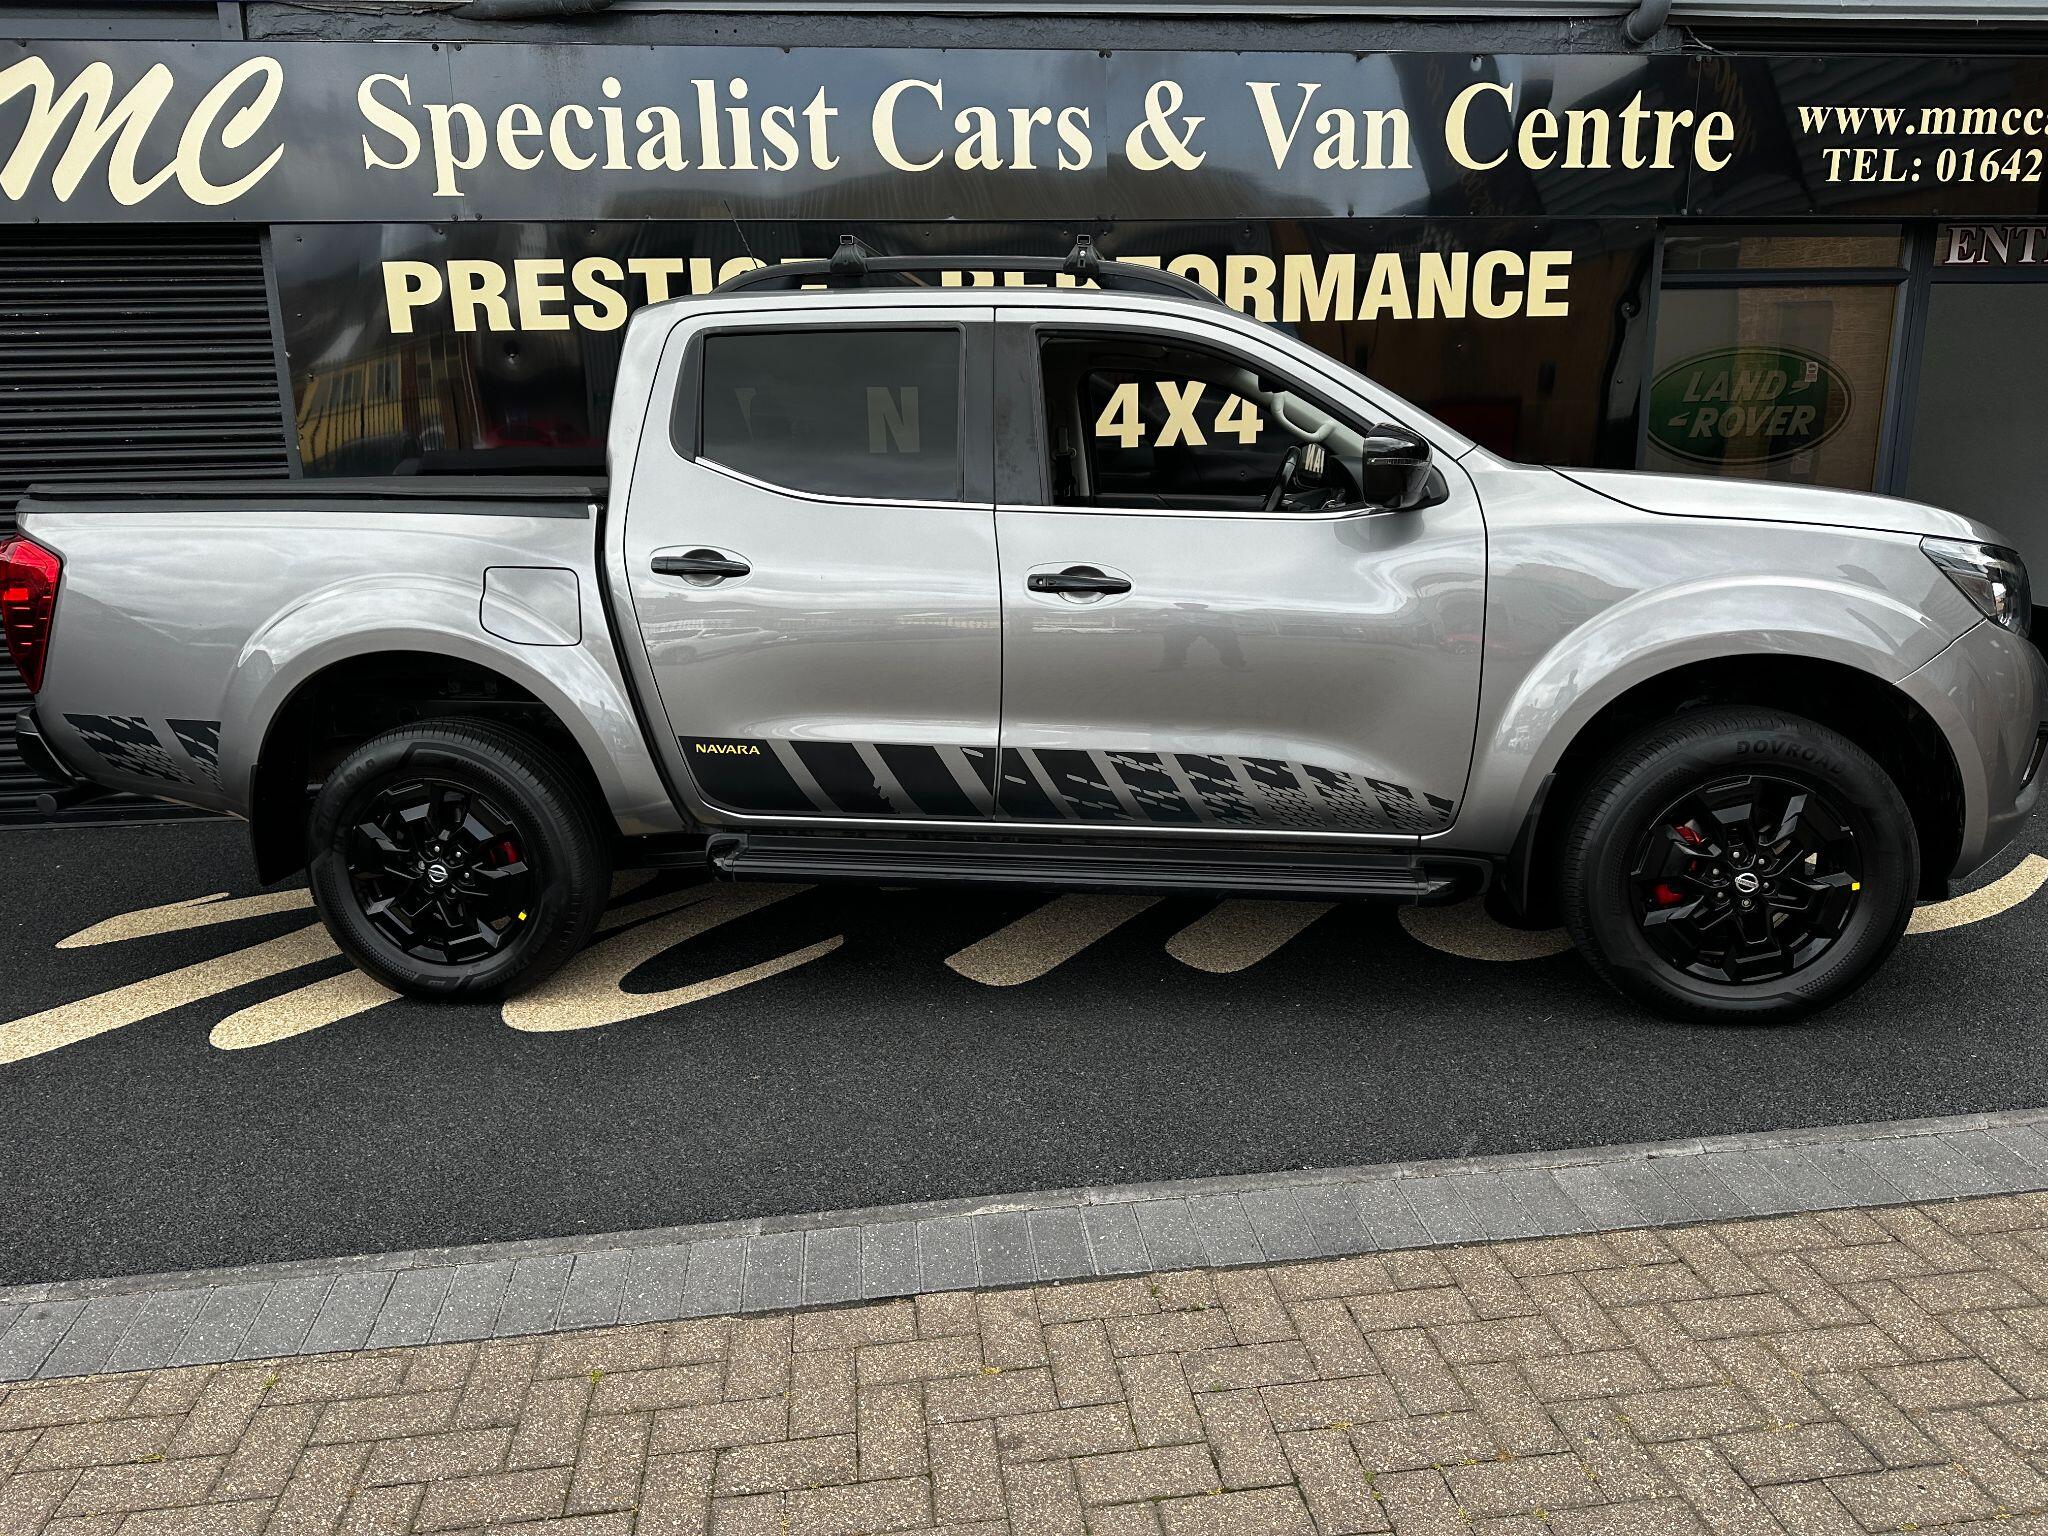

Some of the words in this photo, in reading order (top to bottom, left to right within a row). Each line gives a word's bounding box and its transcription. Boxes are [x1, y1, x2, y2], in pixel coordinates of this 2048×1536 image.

[357, 74, 840, 197] Specialist
[872, 78, 1093, 172] Cars
[1125, 80, 1206, 171] &
[1246, 82, 1411, 170] Van
[1444, 82, 1735, 172] Centre
[1798, 106, 2048, 136] www.mmcc
[1822, 148, 1922, 182] TEL:
[1936, 148, 2043, 182] 01642
[1943, 226, 2048, 265] ENT
[382, 256, 829, 333] PRESTI
[1682, 369, 1788, 402] LAND
[1095, 380, 1264, 448] 4X4
[1687, 404, 1817, 438] ROVER
[695, 743, 761, 755] NAVARA
[1735, 739, 1847, 775] DOVROAD
